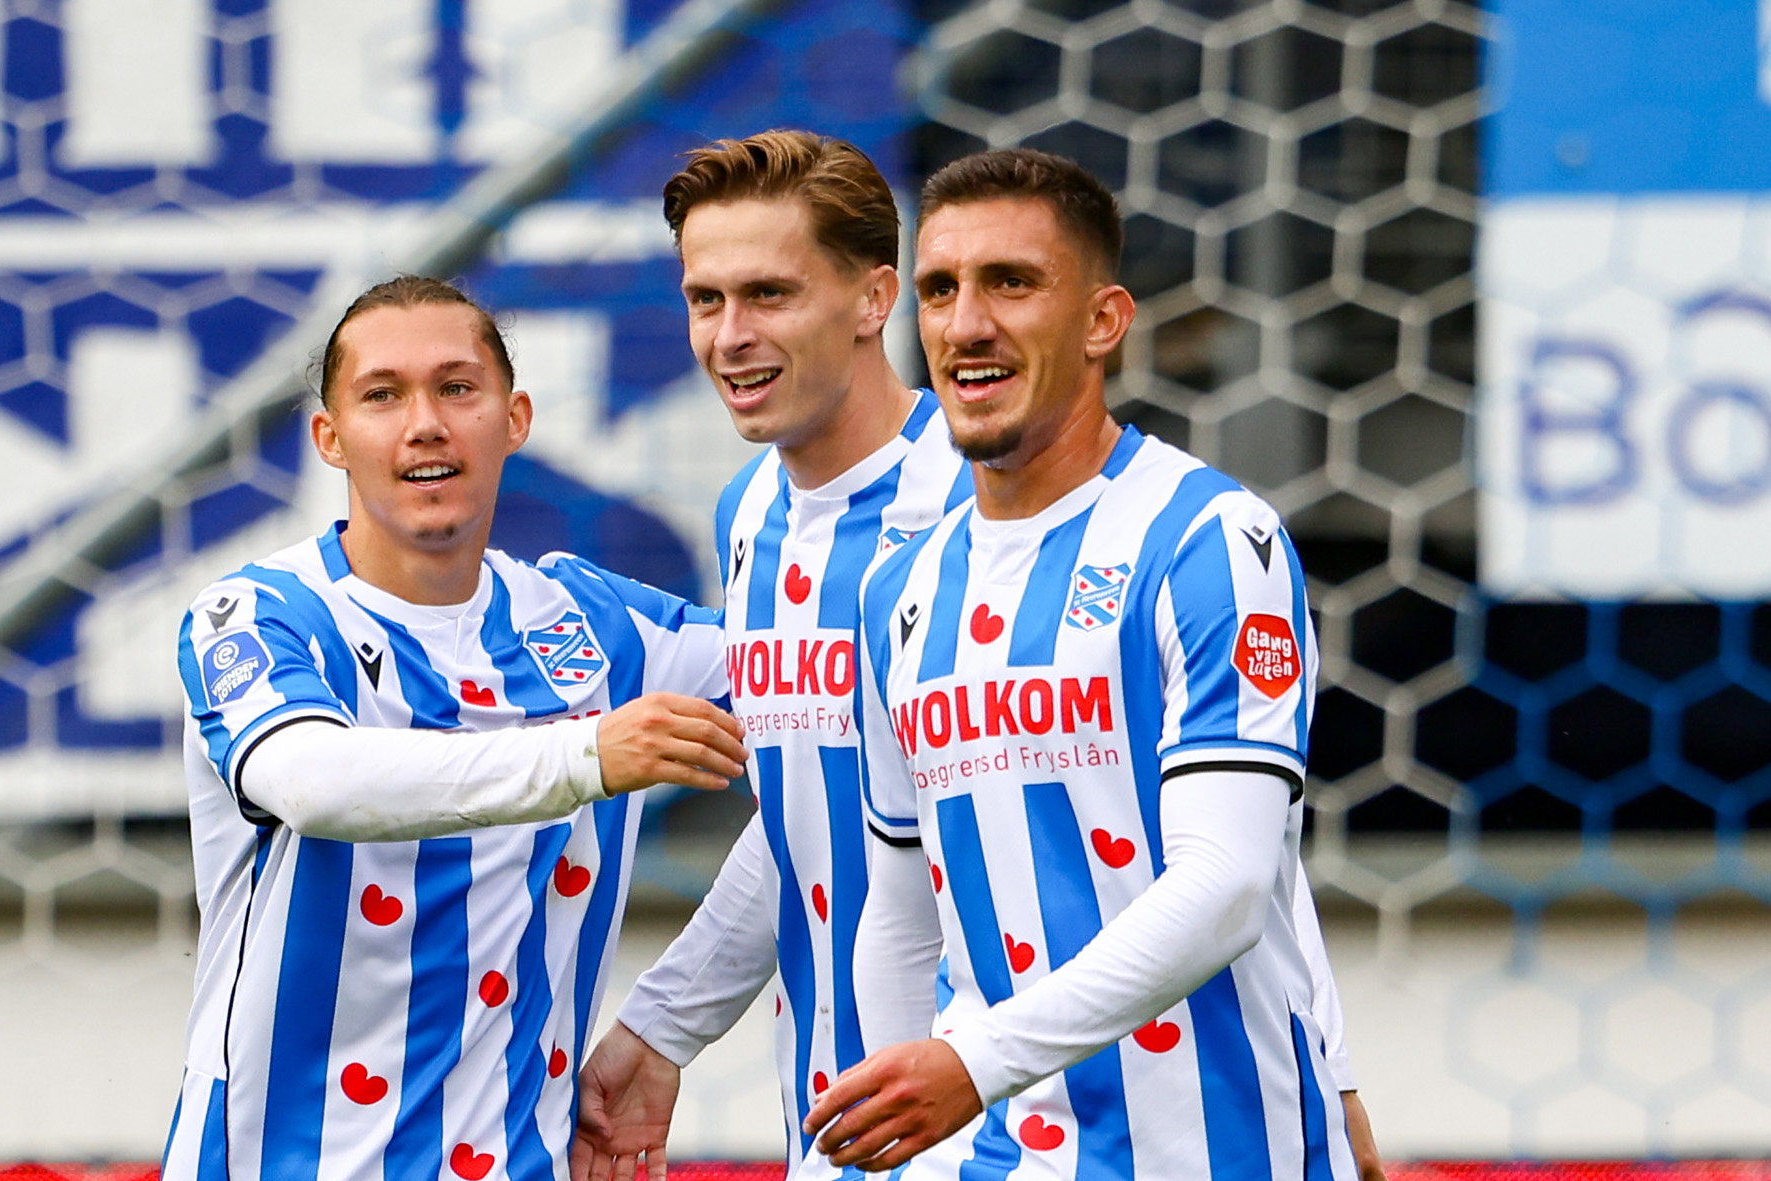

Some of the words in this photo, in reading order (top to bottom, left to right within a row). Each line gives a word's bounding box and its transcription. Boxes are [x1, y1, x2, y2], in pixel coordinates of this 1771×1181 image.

[1246, 626, 1292, 657] Gang
[1254, 649, 1281, 664] van
[740, 706, 810, 737] egrensd
[892, 676, 1114, 760] WOLKOM
[1019, 742, 1120, 774] Fryslân
